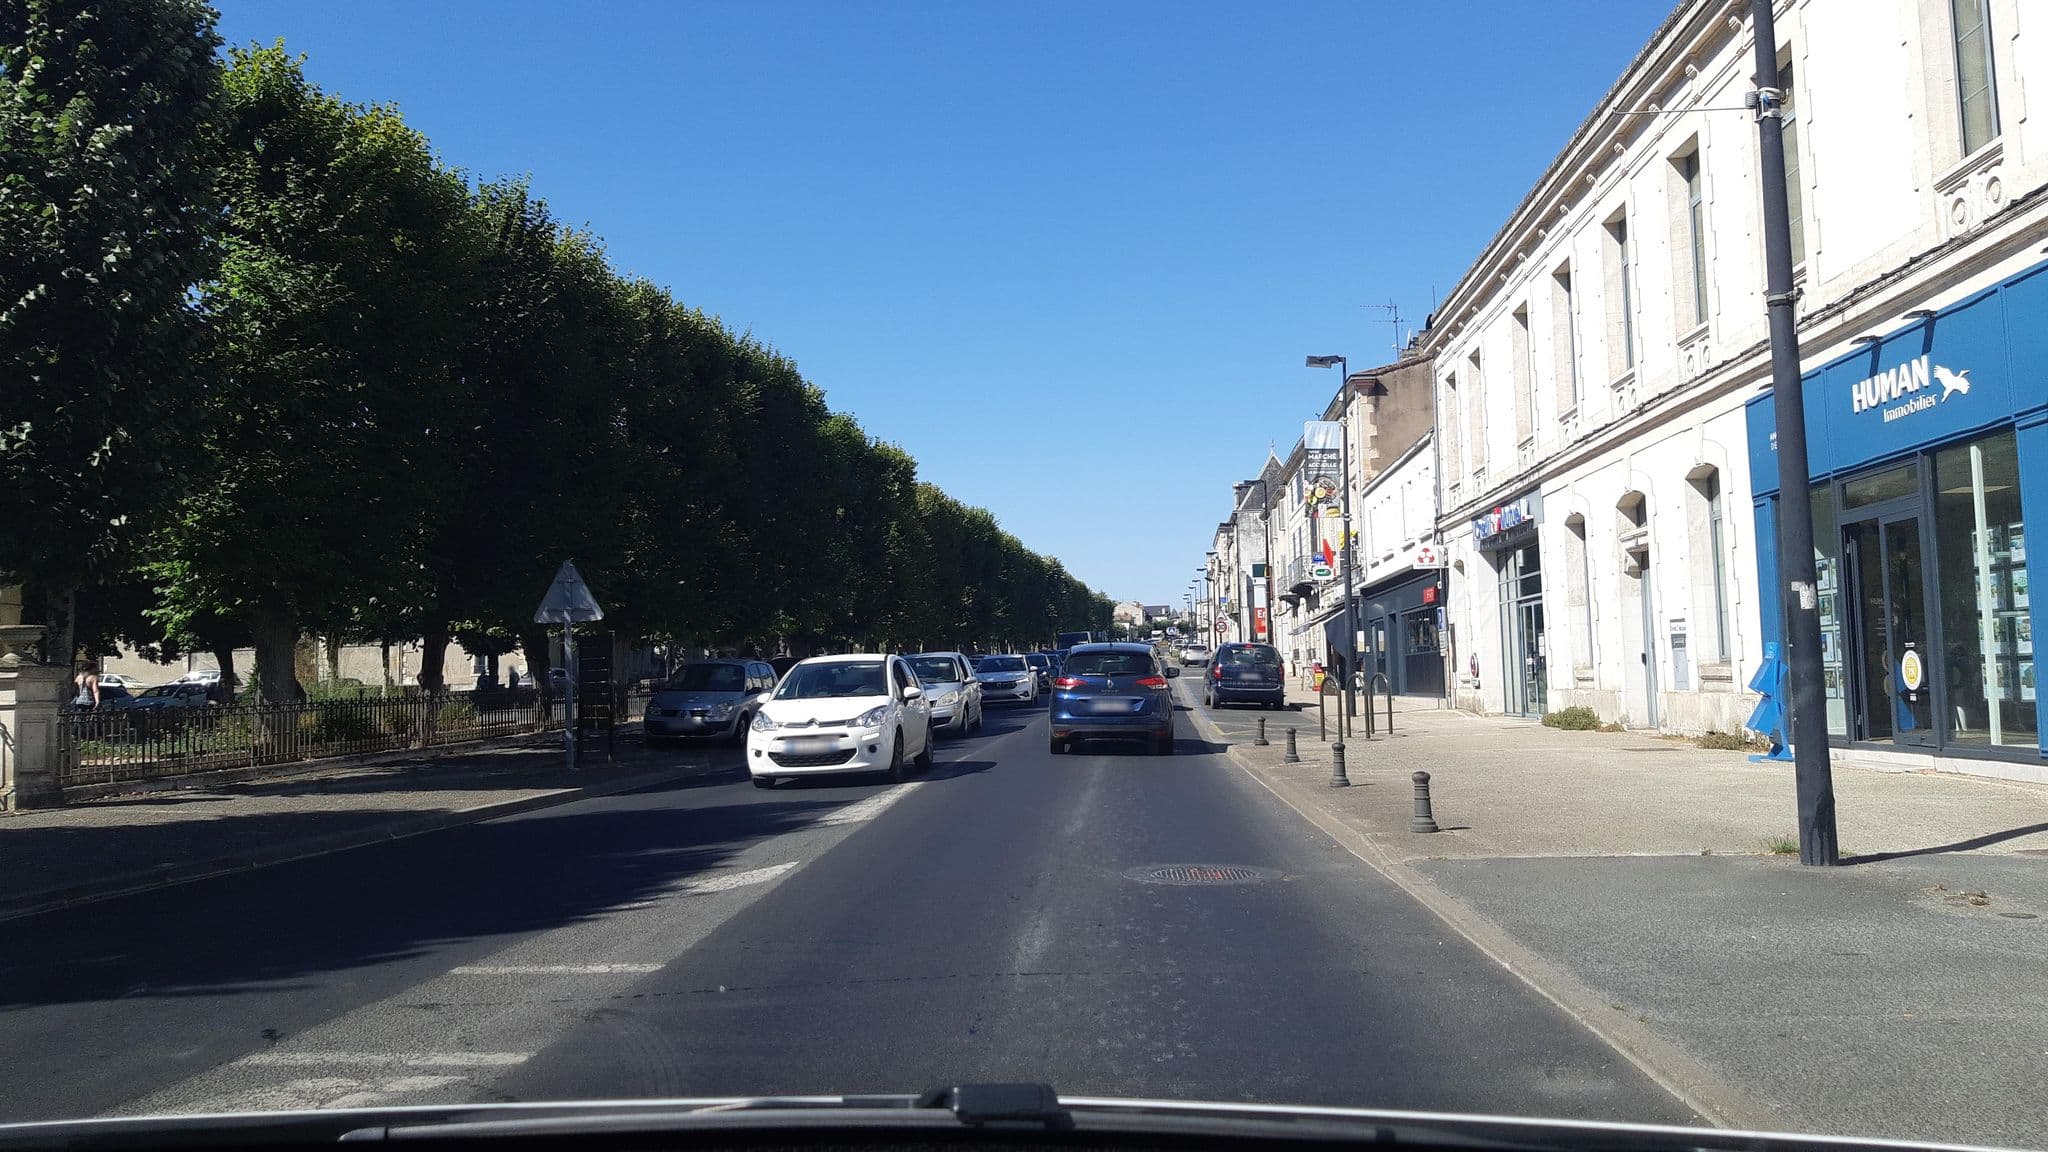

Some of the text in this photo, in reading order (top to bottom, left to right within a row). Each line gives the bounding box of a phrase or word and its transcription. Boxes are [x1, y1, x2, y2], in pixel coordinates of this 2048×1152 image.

[1852, 355, 1930, 414] HUMAN
[1883, 394, 1937, 423] Immobilier
[1217, 623, 1226, 631] 30
